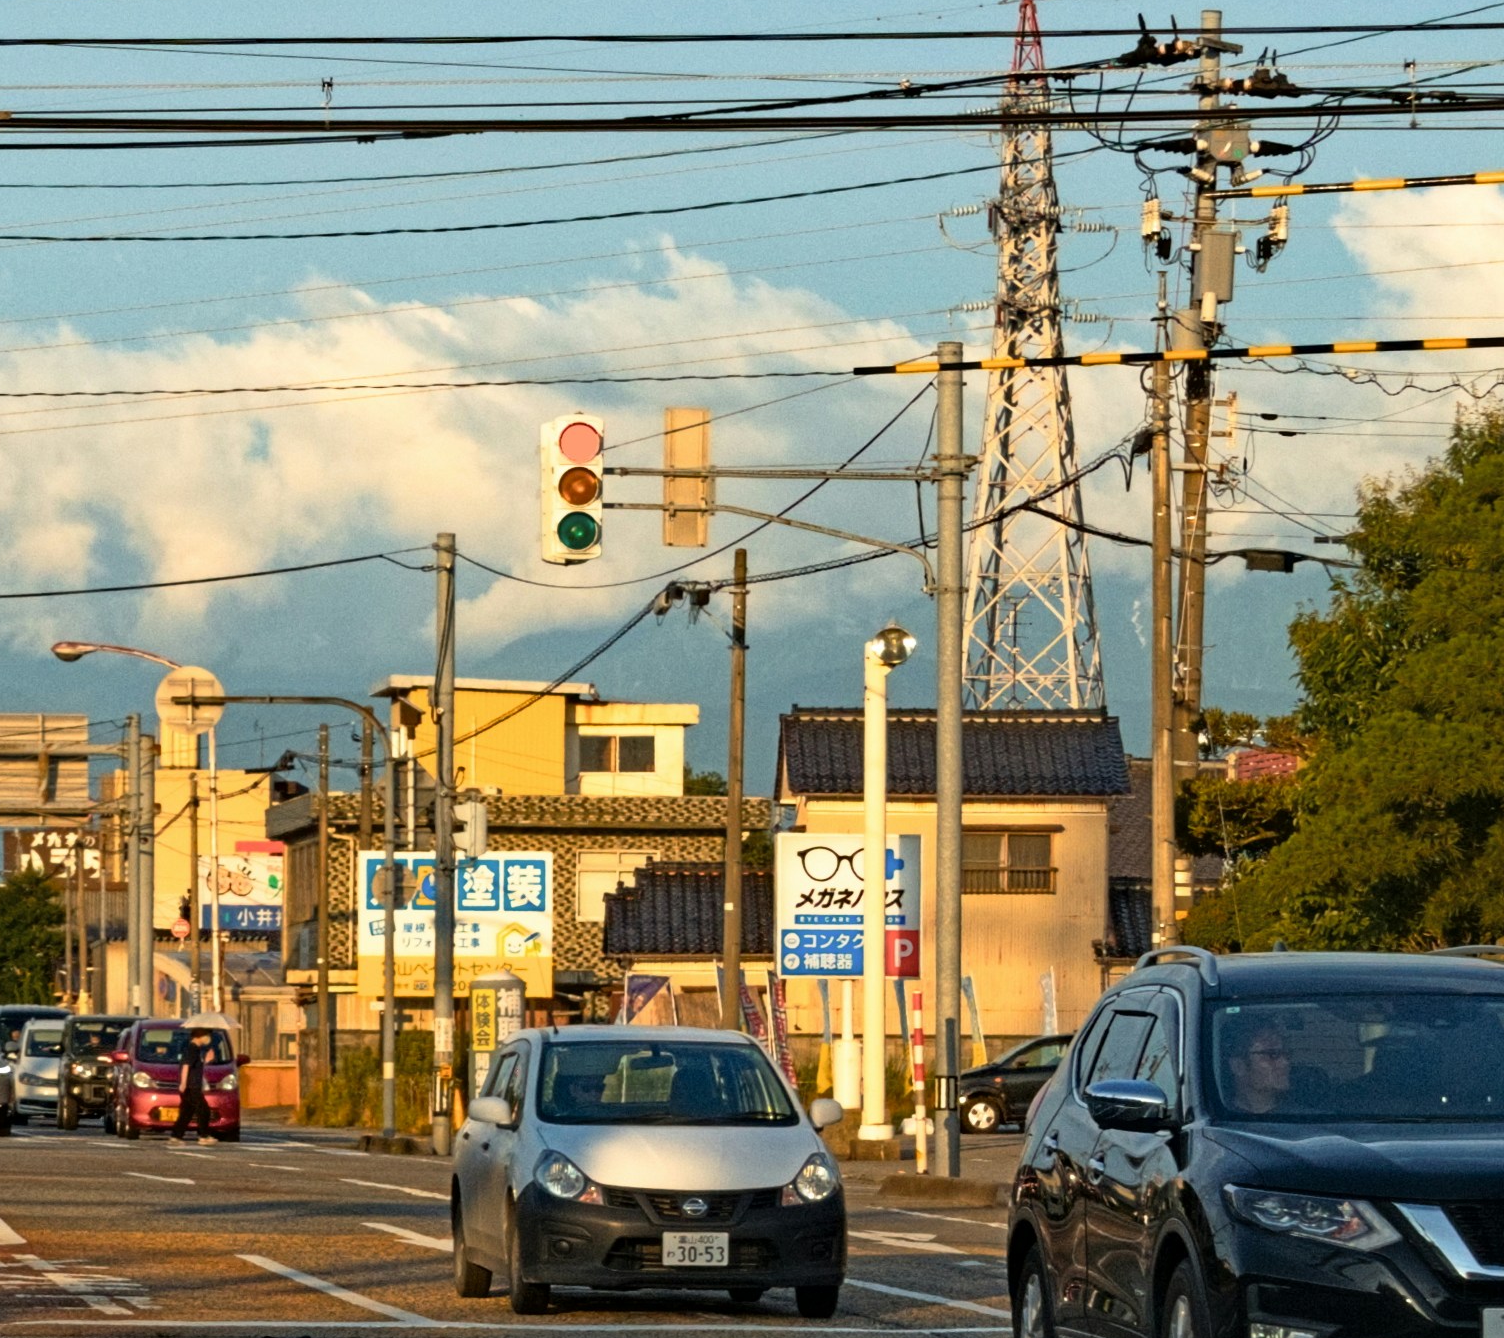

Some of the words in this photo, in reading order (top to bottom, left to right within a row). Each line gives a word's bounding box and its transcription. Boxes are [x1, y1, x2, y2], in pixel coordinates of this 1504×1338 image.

[795, 888, 905, 909] メガネス
[403, 922, 480, 933] 屋根・工事
[403, 936, 480, 948] リフォ工事
[803, 934, 864, 949] コンタク
[803, 952, 854, 970] 補聴器
[894, 938, 914, 968] P
[475, 992, 491, 1047] 体験会
[677, 1245, 725, 1263] 30-53
